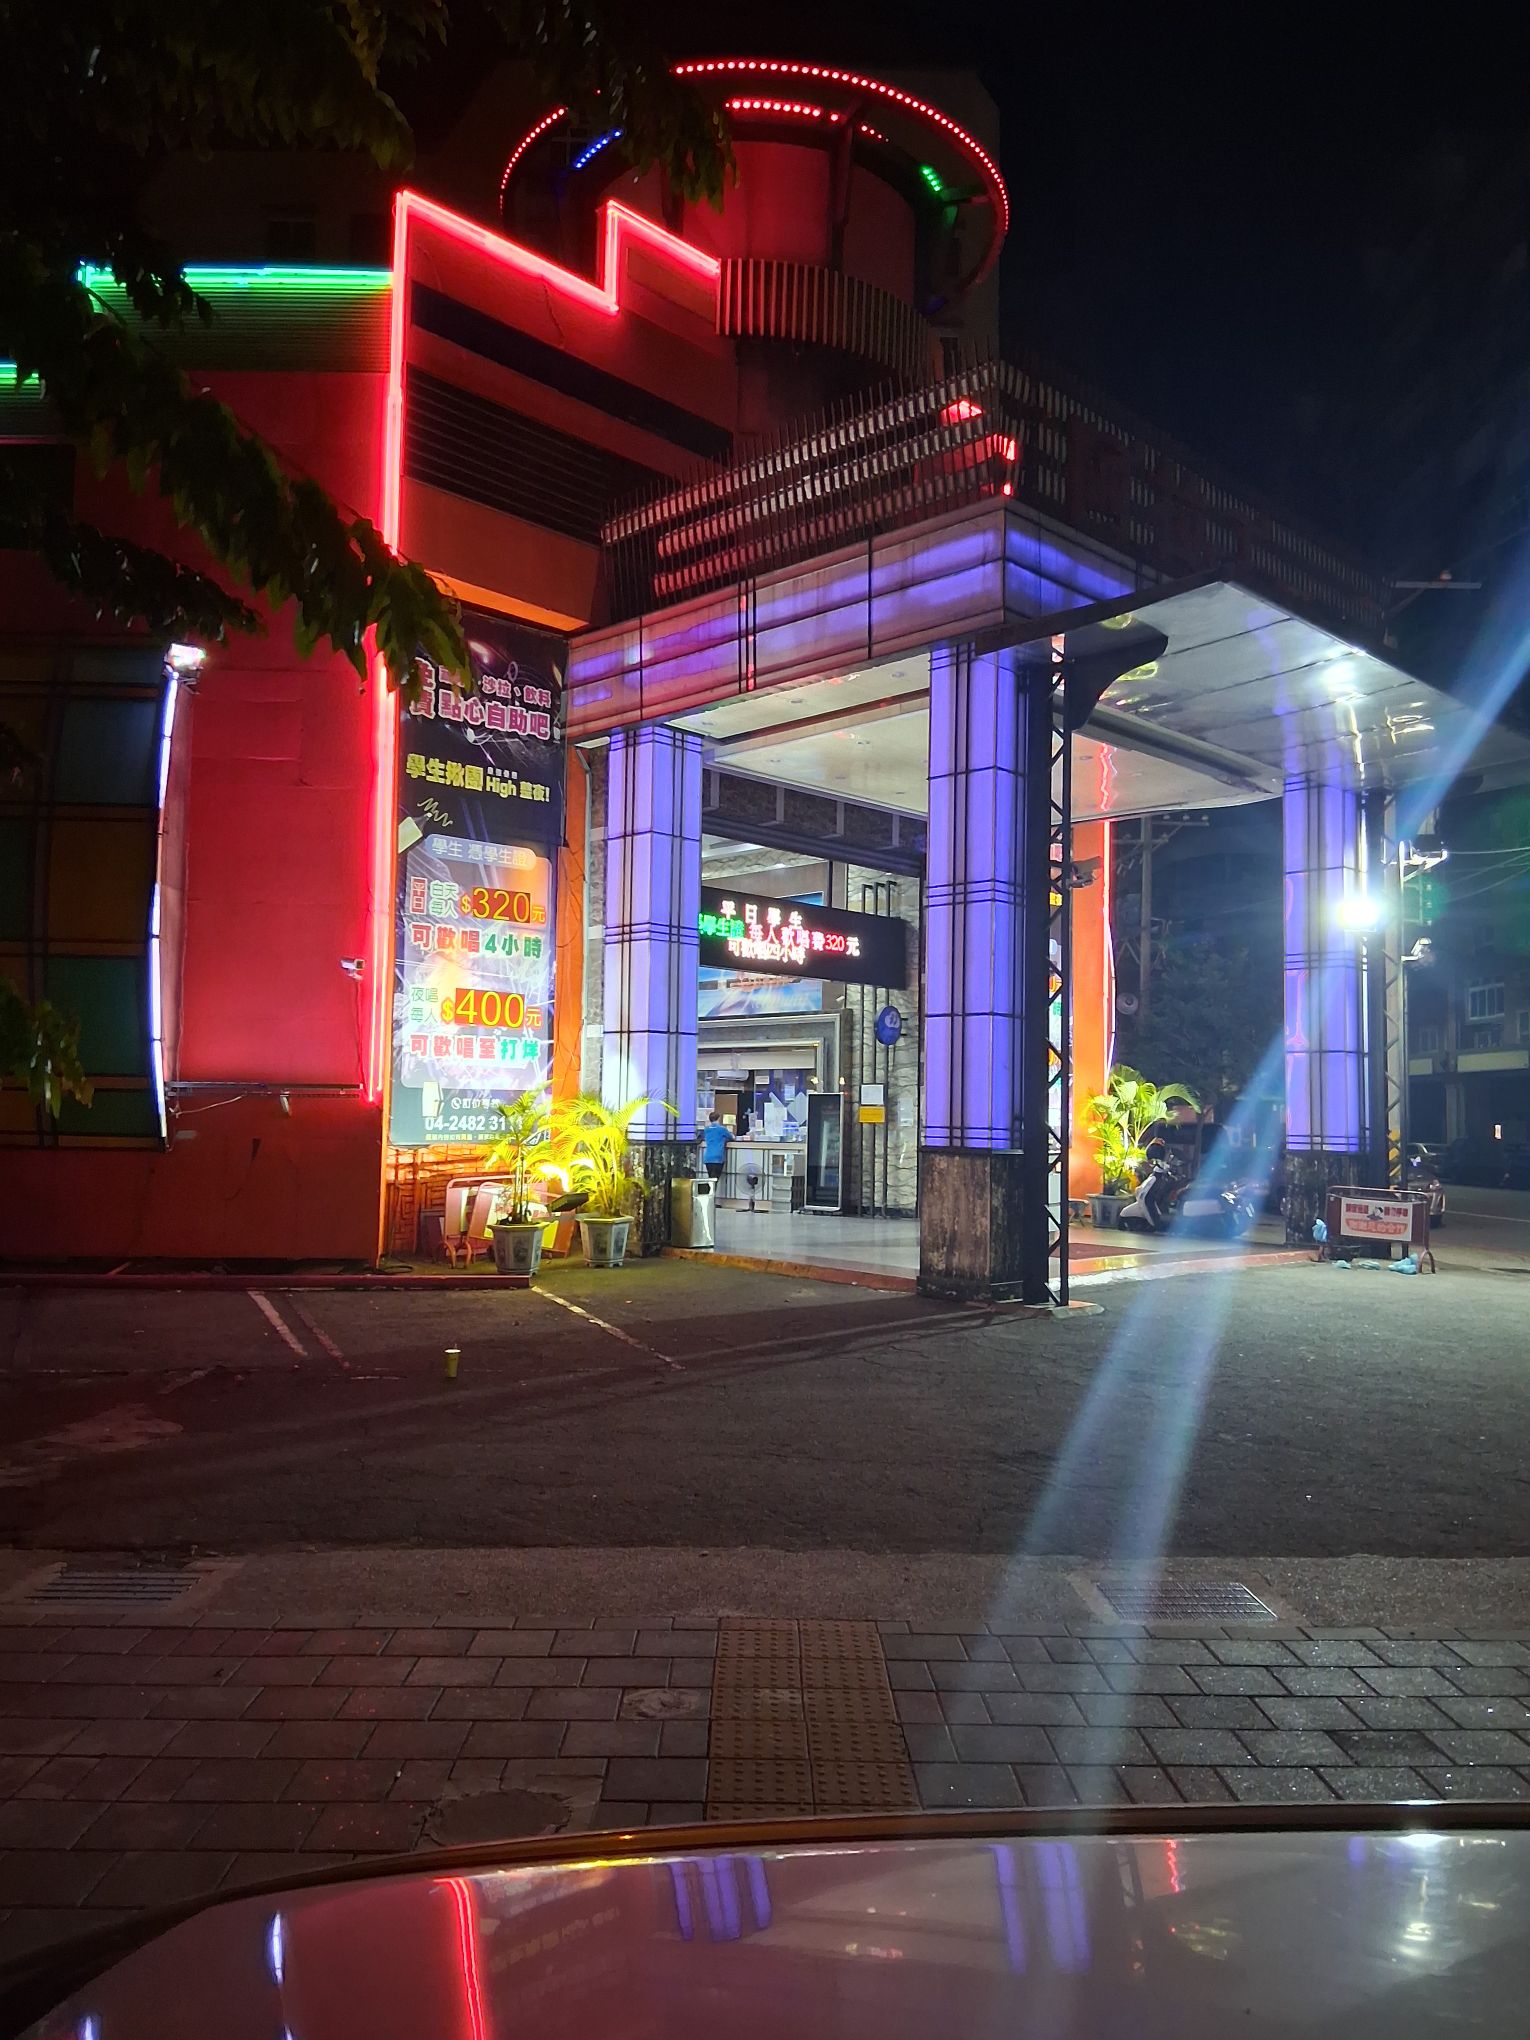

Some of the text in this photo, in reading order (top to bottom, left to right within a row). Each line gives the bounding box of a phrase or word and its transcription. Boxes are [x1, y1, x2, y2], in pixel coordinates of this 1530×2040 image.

[482, 675, 551, 708] 沙拉、飲料
[438, 688, 551, 740] 點心自助吧
[486, 776, 517, 798] High
[431, 838, 463, 858] 學生
[411, 924, 543, 959] 可歡唱4小時
